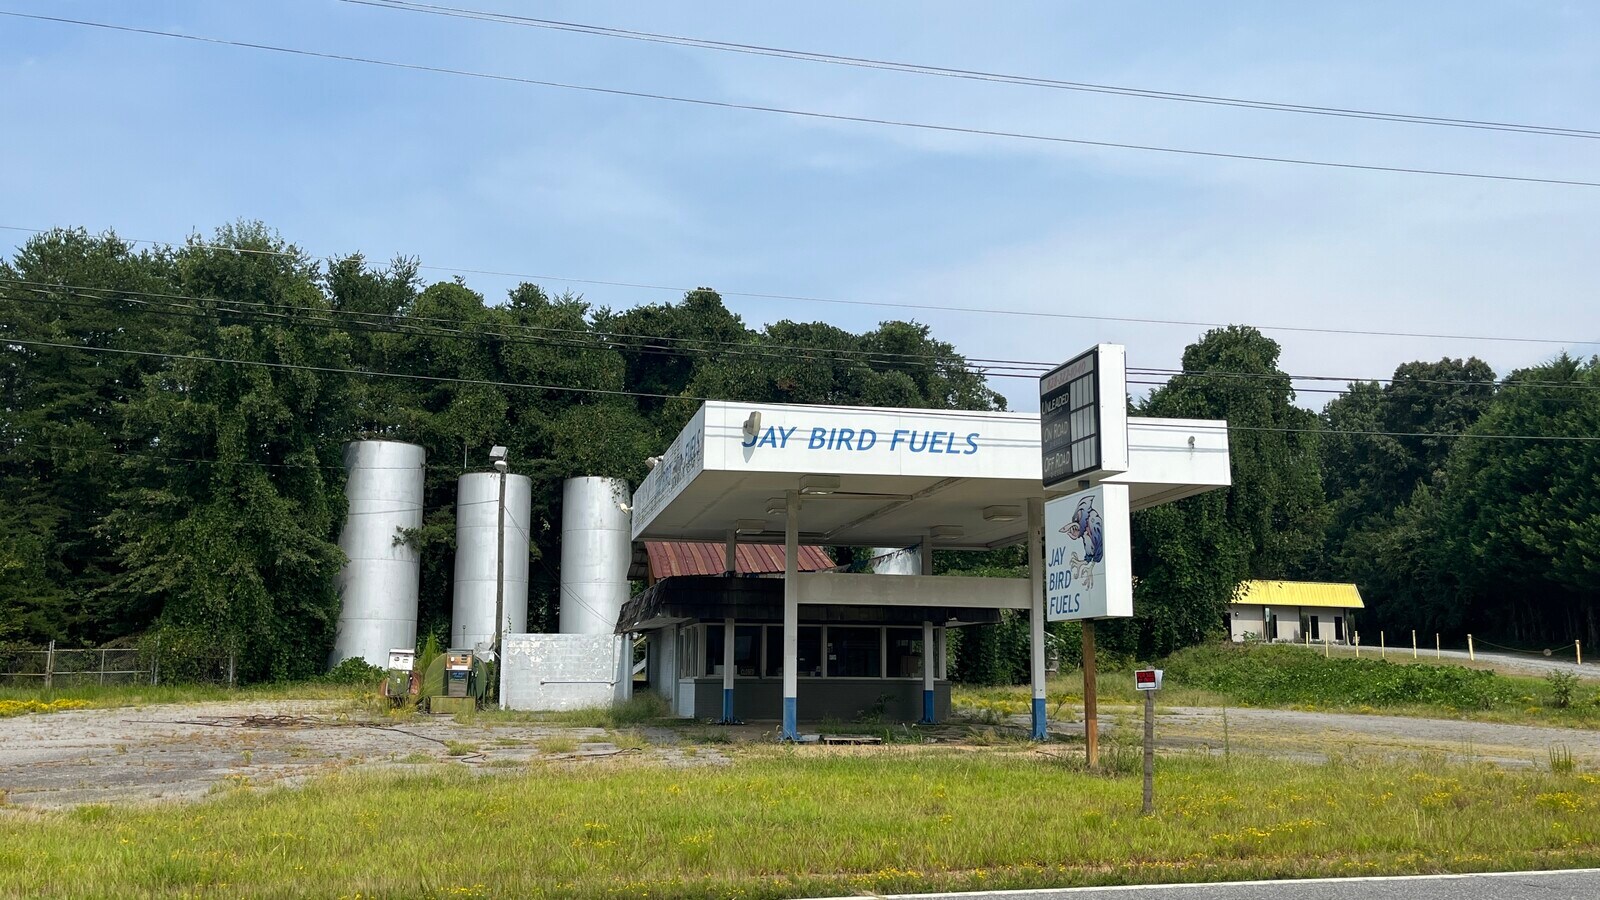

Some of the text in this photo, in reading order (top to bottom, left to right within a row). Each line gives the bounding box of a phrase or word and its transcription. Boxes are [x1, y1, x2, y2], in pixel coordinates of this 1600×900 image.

[1041, 393, 1069, 415] UNLEADED
[742, 426, 980, 455] JAY BIRD FUELS
[1044, 427, 1053, 443] ON
[1053, 421, 1068, 440] ROAD
[1044, 451, 1070, 473] OFF ROAD
[1048, 546, 1066, 567] JAY
[1049, 570, 1072, 591] BIRD
[1049, 593, 1080, 615] FUELS
